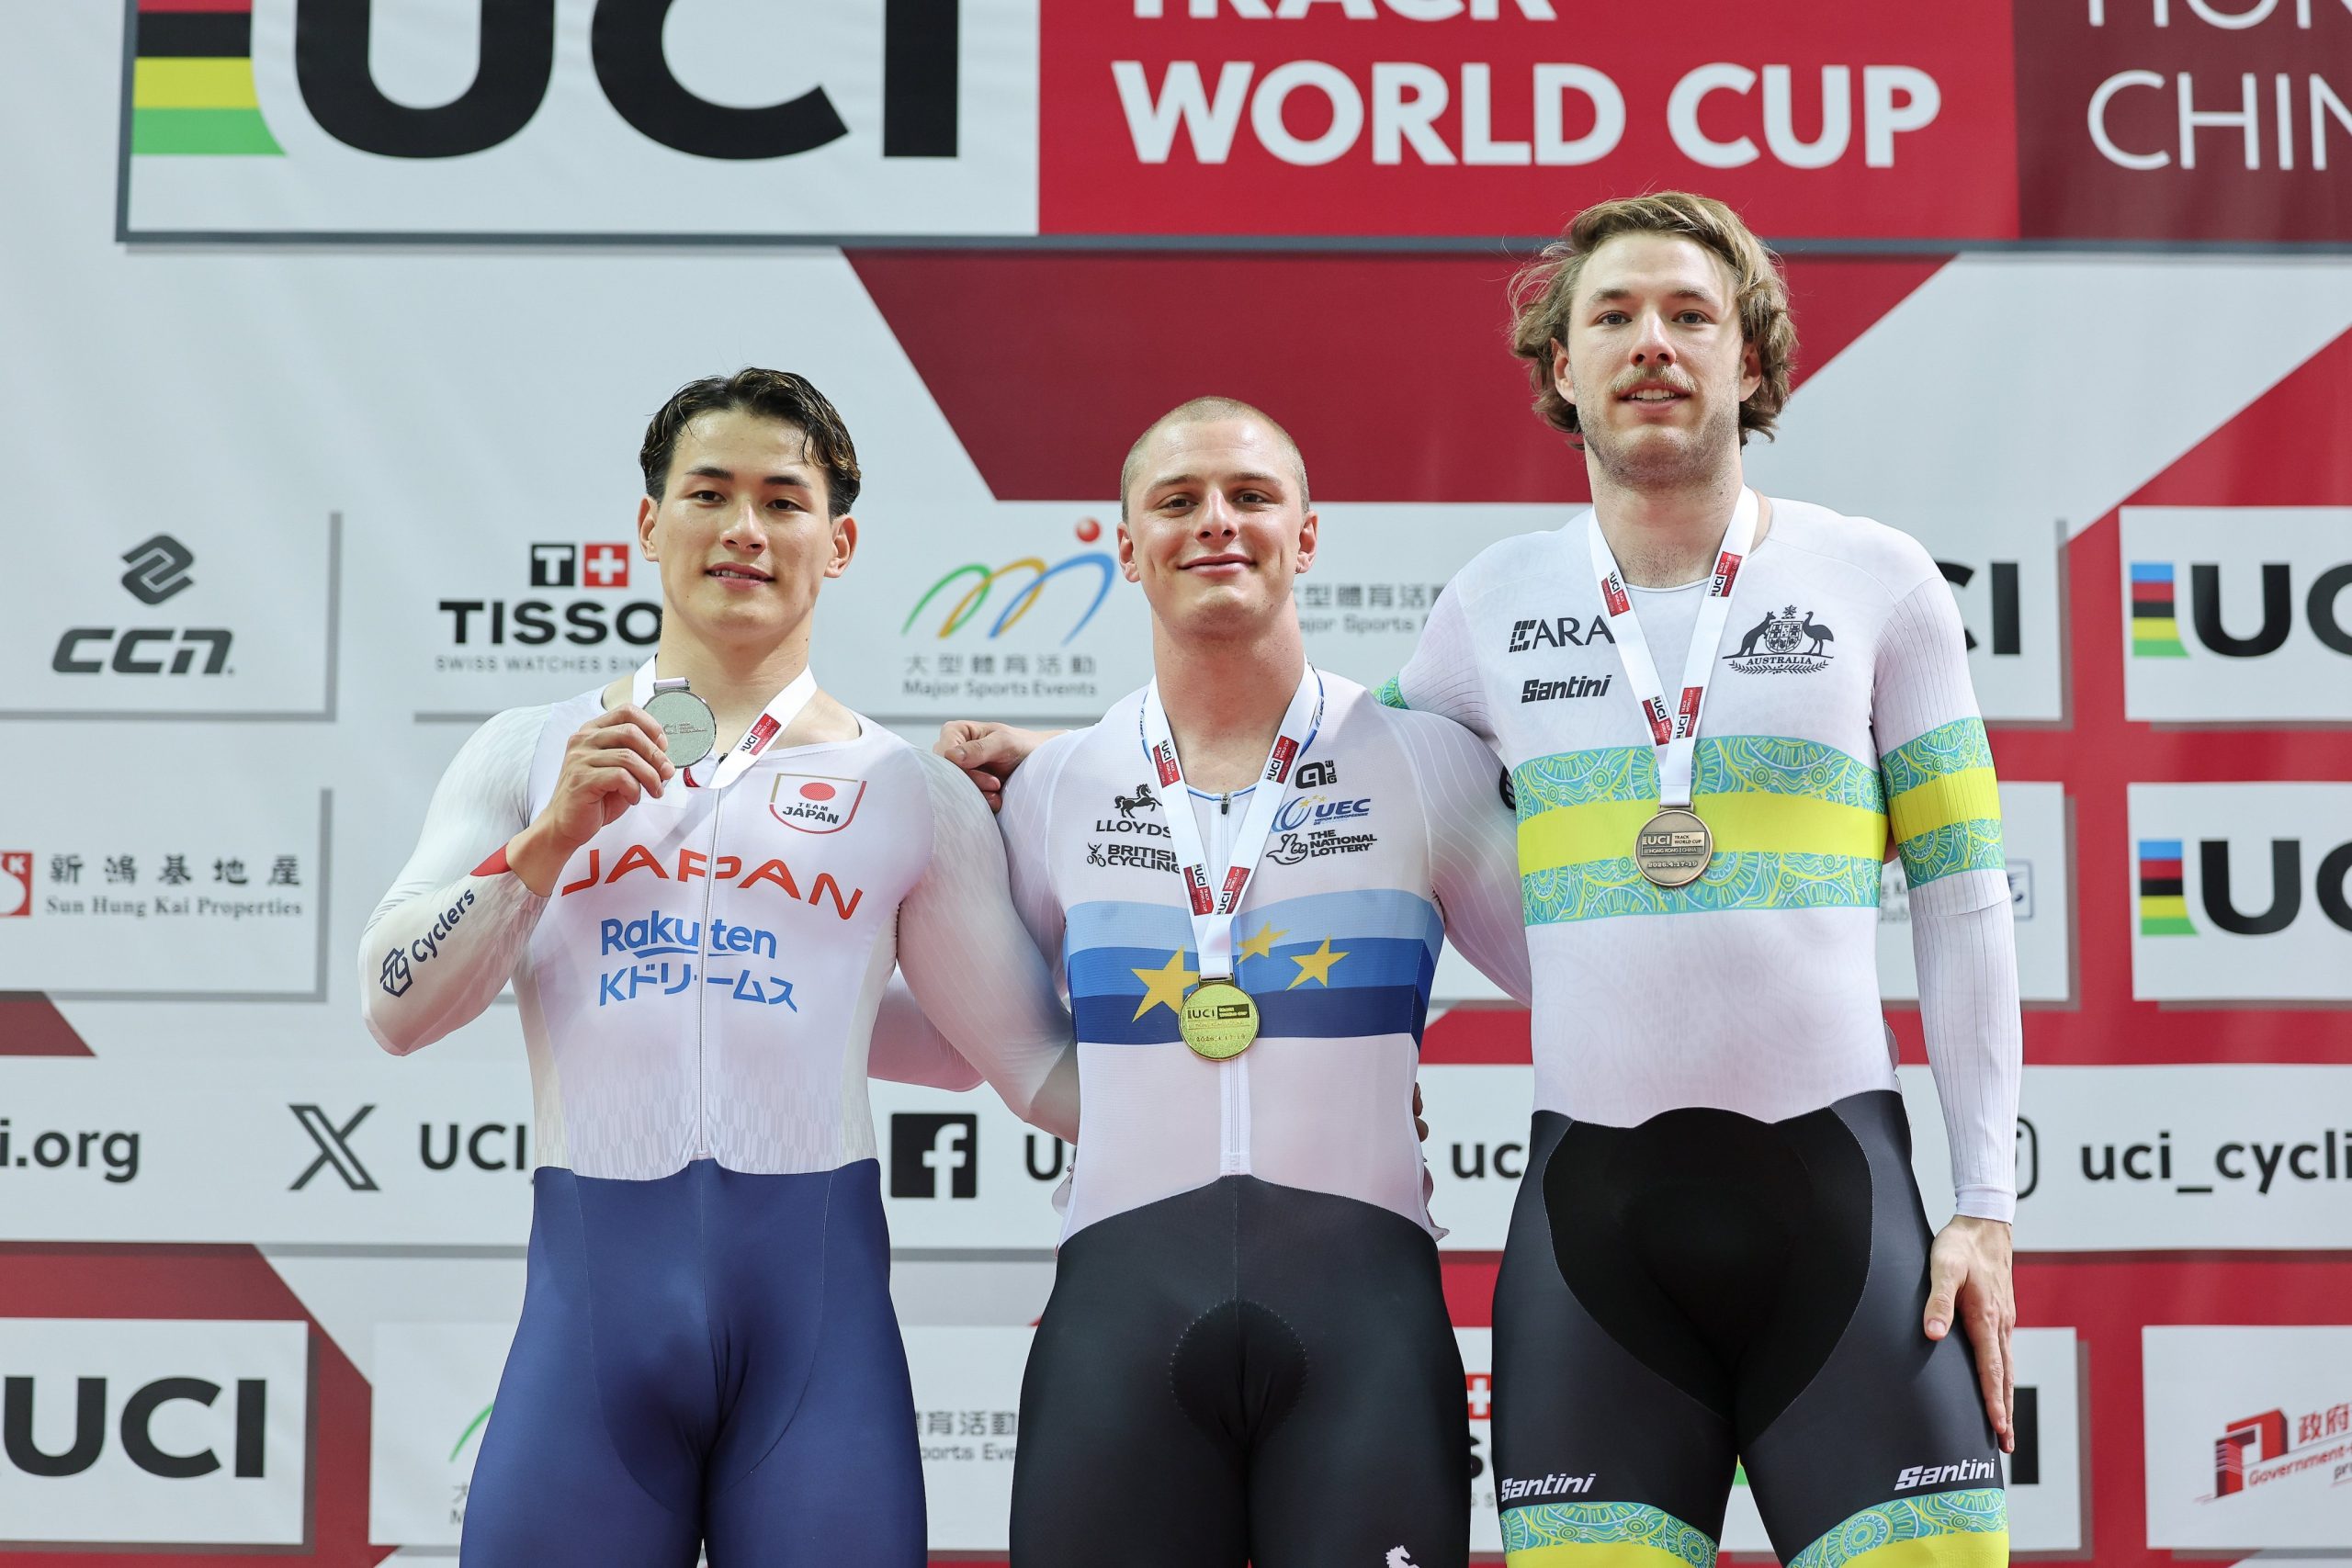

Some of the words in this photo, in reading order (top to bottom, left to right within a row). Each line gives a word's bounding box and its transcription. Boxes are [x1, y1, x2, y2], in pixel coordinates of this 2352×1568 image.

[296, 0, 958, 160] UCI
[1112, 60, 1625, 166] WORLD
[1667, 63, 1940, 168] CUP
[1609, 573, 1620, 592] UCI
[1712, 576, 1724, 592] UCI
[1747, 656, 1812, 666] AUSTRALIA
[904, 682, 958, 699] Major
[967, 682, 1027, 699] Sports
[1033, 682, 1096, 695] Events
[1521, 675, 1611, 703] Santini
[1654, 700, 1666, 719] UCI
[1676, 716, 1688, 733] UCI
[741, 735, 757, 750] UCI
[1161, 742, 1171, 761] UCI
[1267, 759, 1281, 777] UCI
[783, 807, 840, 825] JAPAN
[798, 802, 829, 811] TEAM
[1315, 798, 1371, 818] UEC
[1096, 819, 1171, 838] LLOYDS
[1308, 829, 1336, 840] THE
[1310, 834, 1377, 849] NATIONAL
[1647, 836, 1670, 845] UCI
[561, 844, 864, 920] JAPAN
[1194, 868, 1205, 886] UCI
[46, 896, 84, 916] Sun
[93, 895, 146, 918] Hung
[154, 894, 189, 916] Kai
[198, 896, 302, 919] Properties
[1217, 893, 1230, 910] UCI
[412, 889, 475, 963] Cyclers
[601, 910, 777, 960] Rakuten
[420, 1123, 535, 1185] UCI
[1025, 1134, 1077, 1181] U
[4, 1376, 266, 1479] UCI
[917, 1412, 1015, 1435] 育活動
[1894, 1459, 1995, 1491] Santini
[2249, 1446, 2352, 1486] Government-
[1501, 1473, 1596, 1502] Santini
